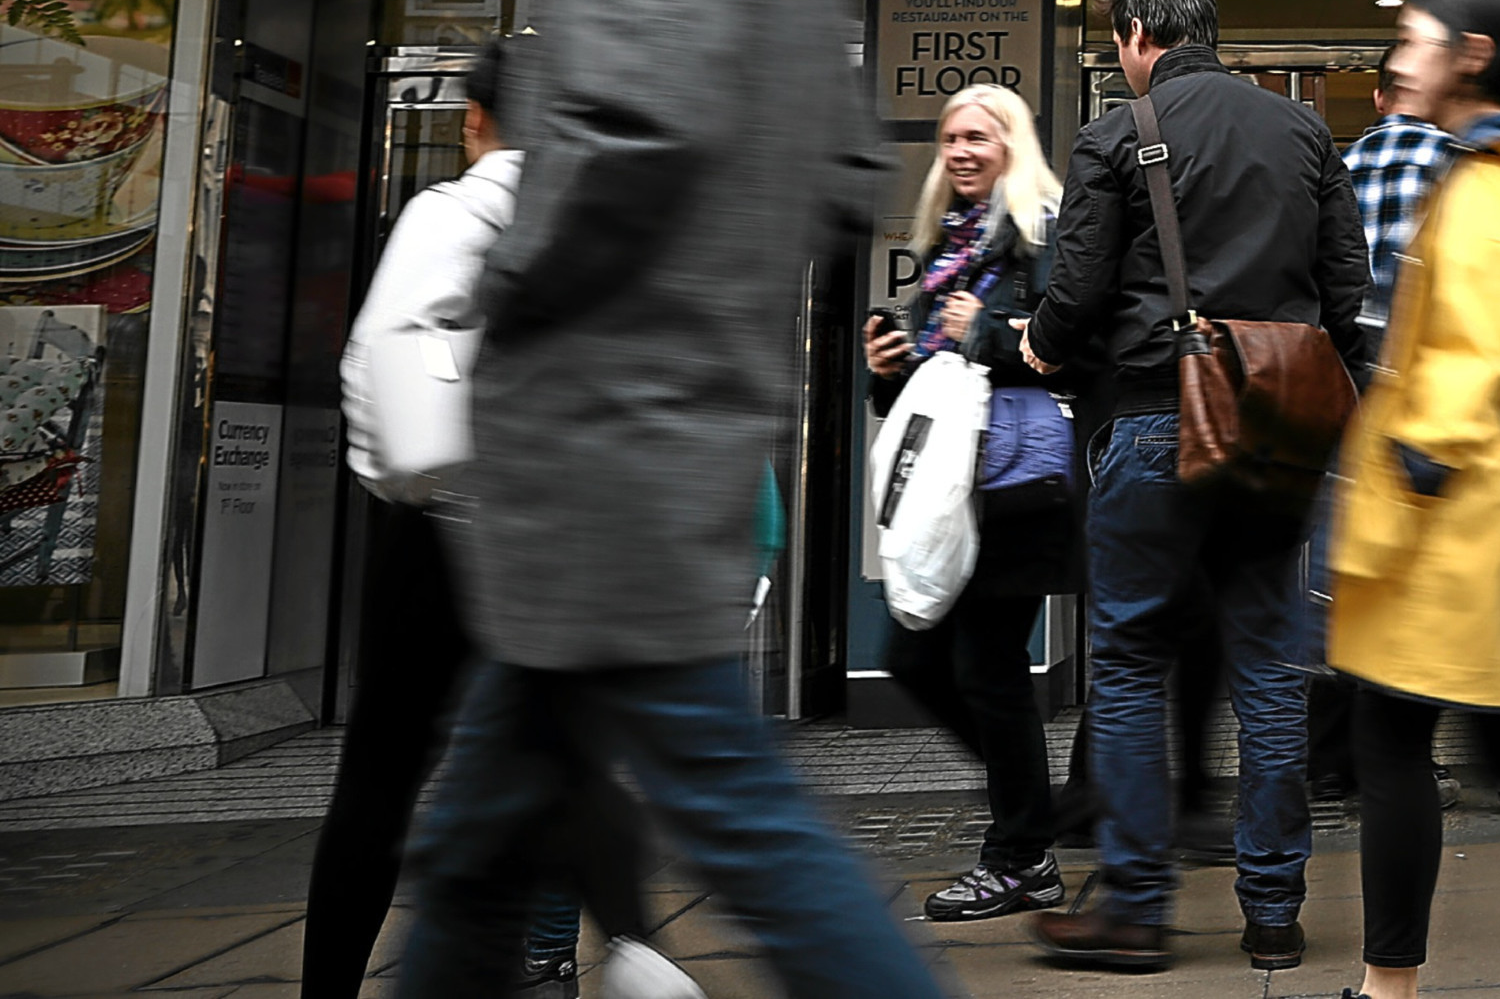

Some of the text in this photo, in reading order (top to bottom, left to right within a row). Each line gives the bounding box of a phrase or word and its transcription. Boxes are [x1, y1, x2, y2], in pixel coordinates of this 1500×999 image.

[892, 11, 1029, 22] RESTAURANT ON THE
[912, 31, 1009, 61] FIRST
[896, 66, 1021, 96] FLOOR
[218, 419, 270, 445] Currency
[214, 445, 269, 470] Exchange
